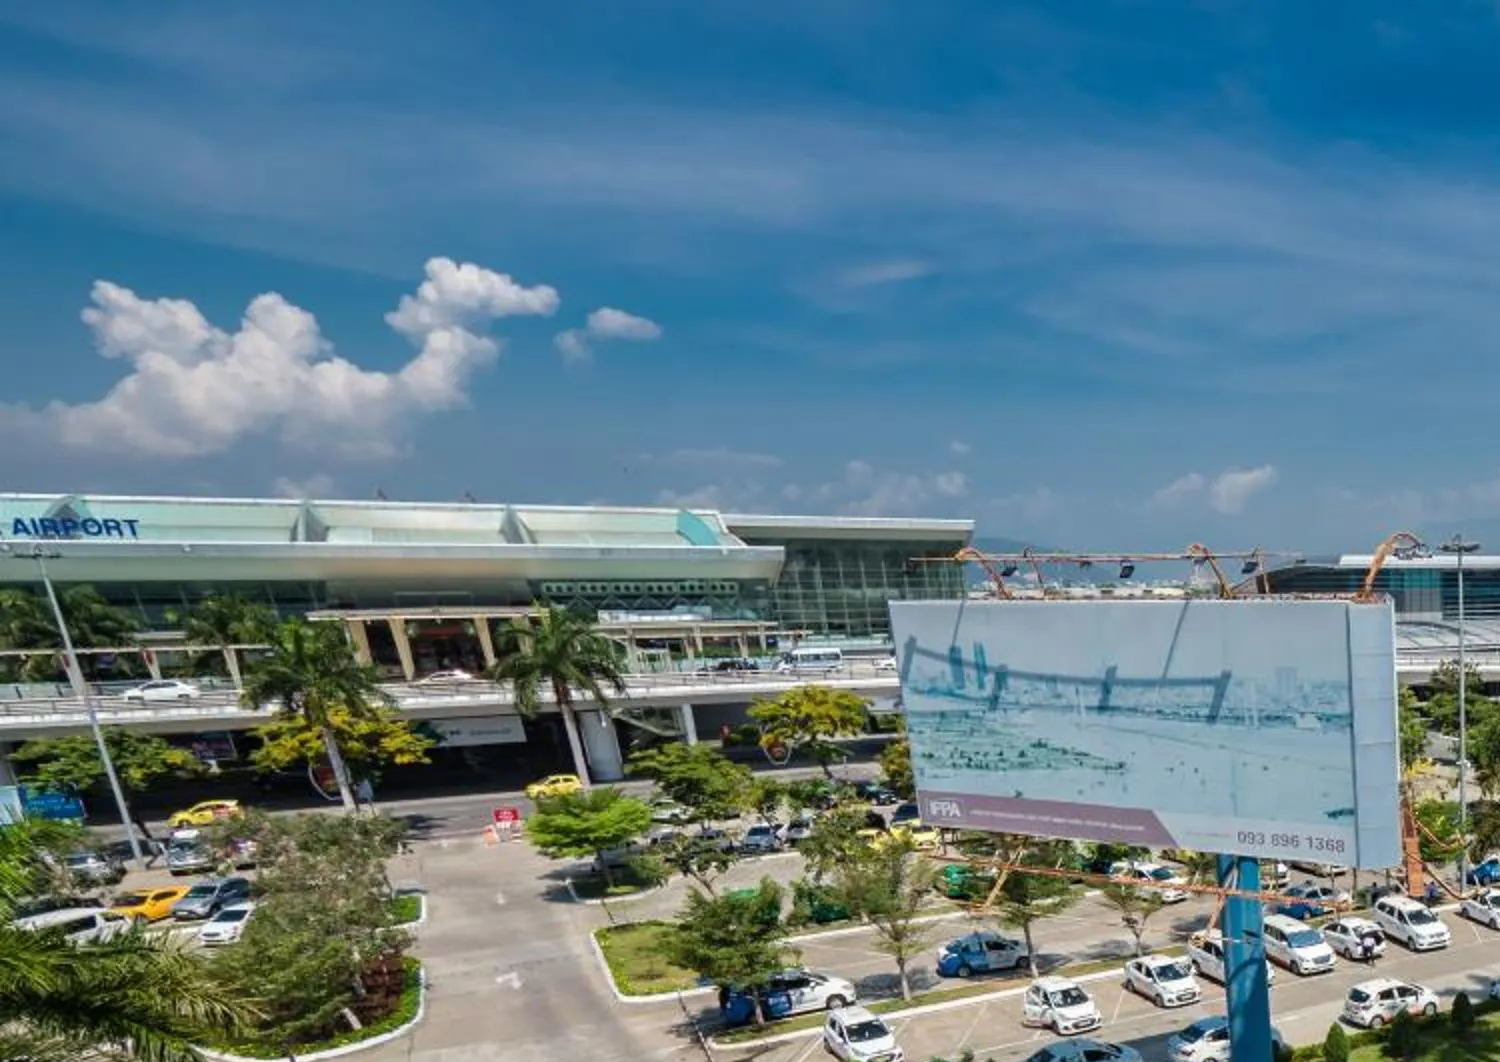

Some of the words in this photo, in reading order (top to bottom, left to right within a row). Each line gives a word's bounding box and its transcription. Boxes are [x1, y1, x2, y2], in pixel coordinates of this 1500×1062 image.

[12, 517, 140, 537] AIRPORT
[1237, 831, 1265, 845] 093
[1271, 833, 1300, 848] 896
[1305, 835, 1345, 852] 1368
